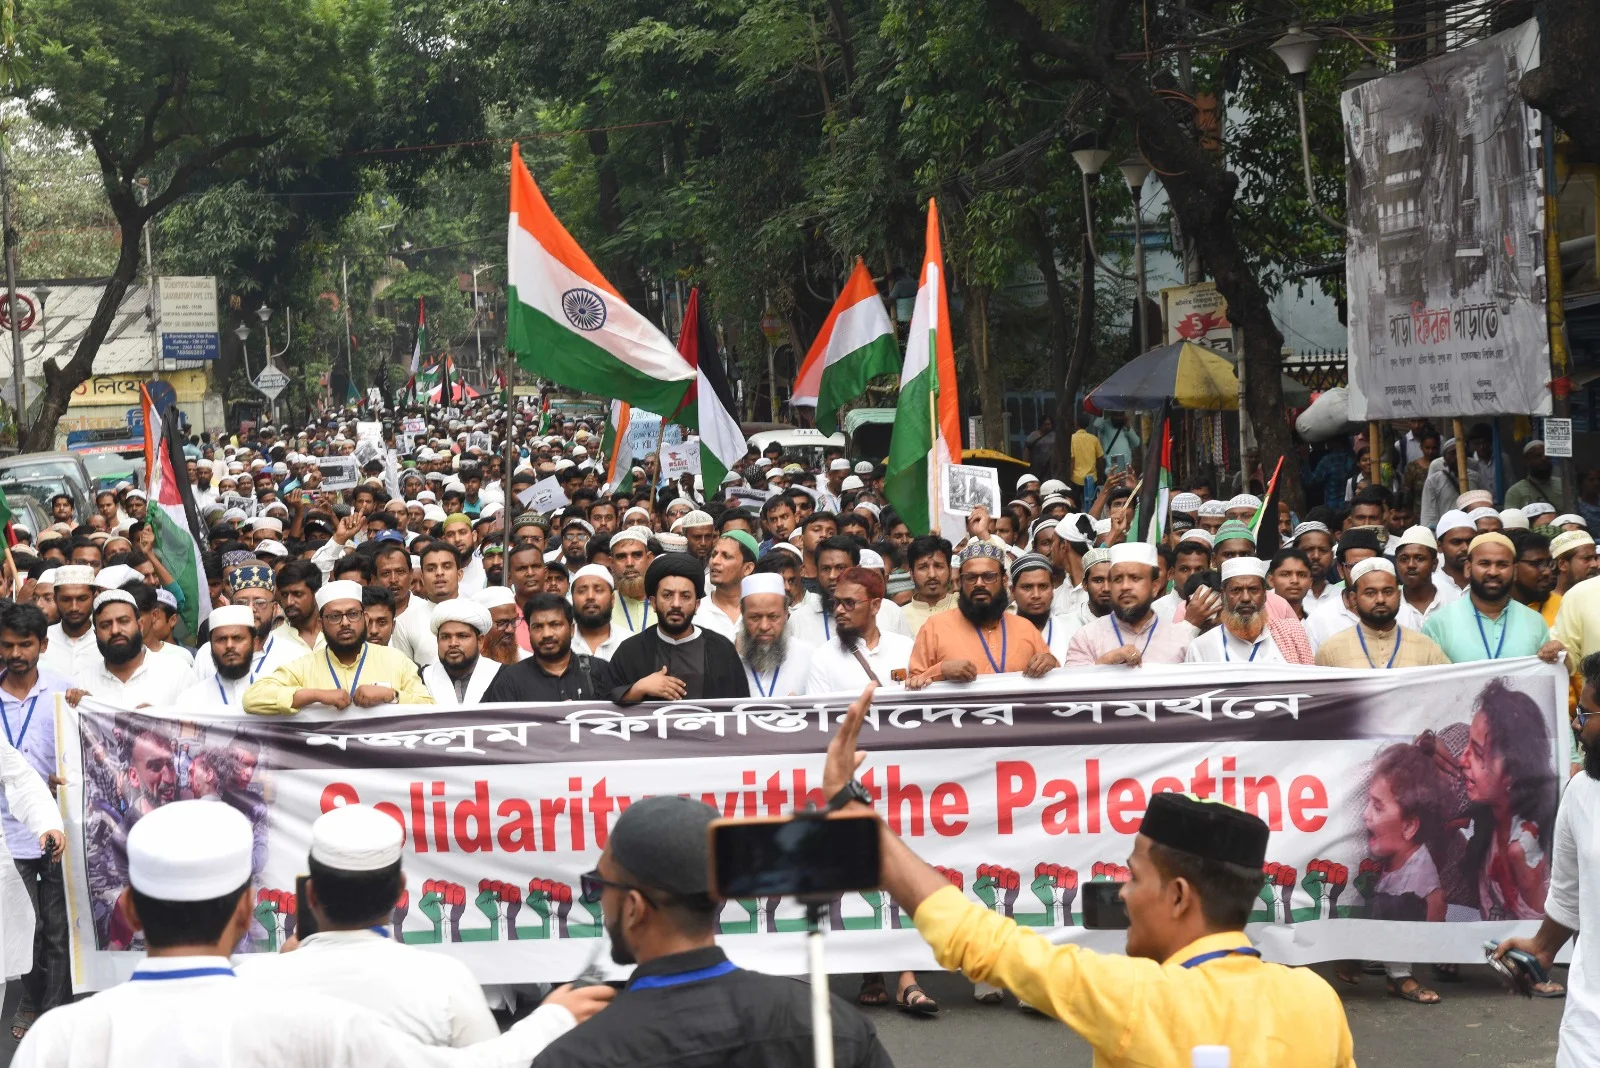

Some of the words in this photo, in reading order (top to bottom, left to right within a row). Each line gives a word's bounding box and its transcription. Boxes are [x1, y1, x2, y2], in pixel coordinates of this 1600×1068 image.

[162, 291, 193, 300] LABORATORY
[1191, 316, 1203, 330] 5
[1389, 313, 1412, 347] পাড়া
[303, 722, 543, 755] মজলুম
[1046, 689, 1312, 724] সমর্থনে
[320, 777, 657, 854] lidarit
[861, 765, 970, 837] the
